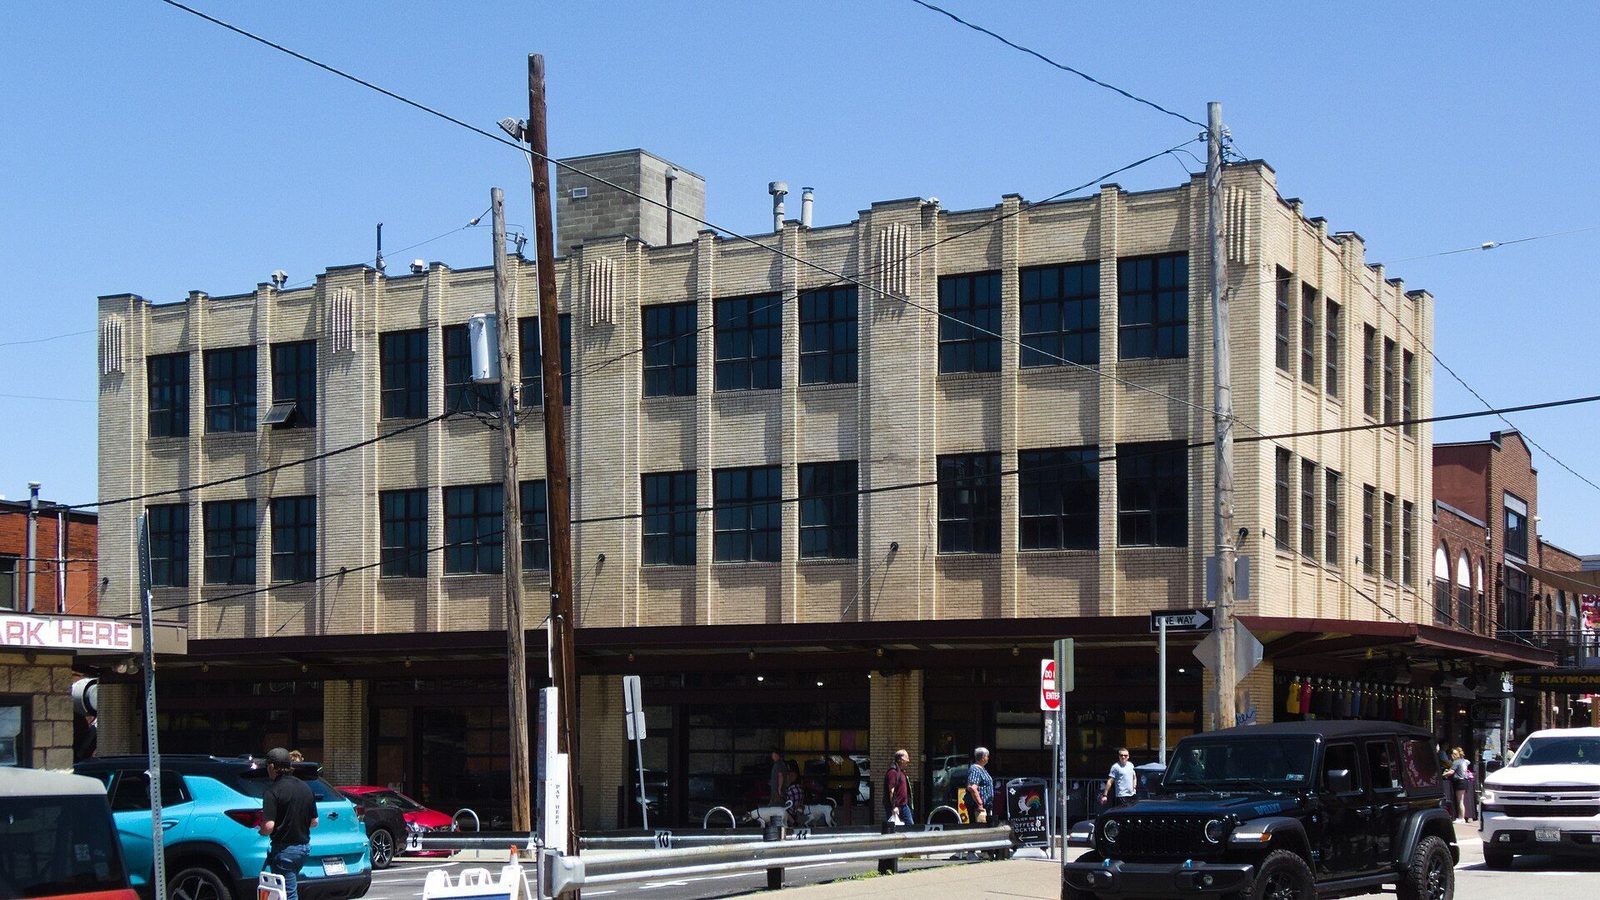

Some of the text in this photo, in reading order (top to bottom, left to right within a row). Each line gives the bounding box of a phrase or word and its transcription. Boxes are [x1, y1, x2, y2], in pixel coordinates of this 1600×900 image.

[1177, 616, 1194, 625] WAY
[0, 619, 129, 647] RK HERE
[1044, 670, 1052, 678] DO
[656, 831, 669, 848] 10
